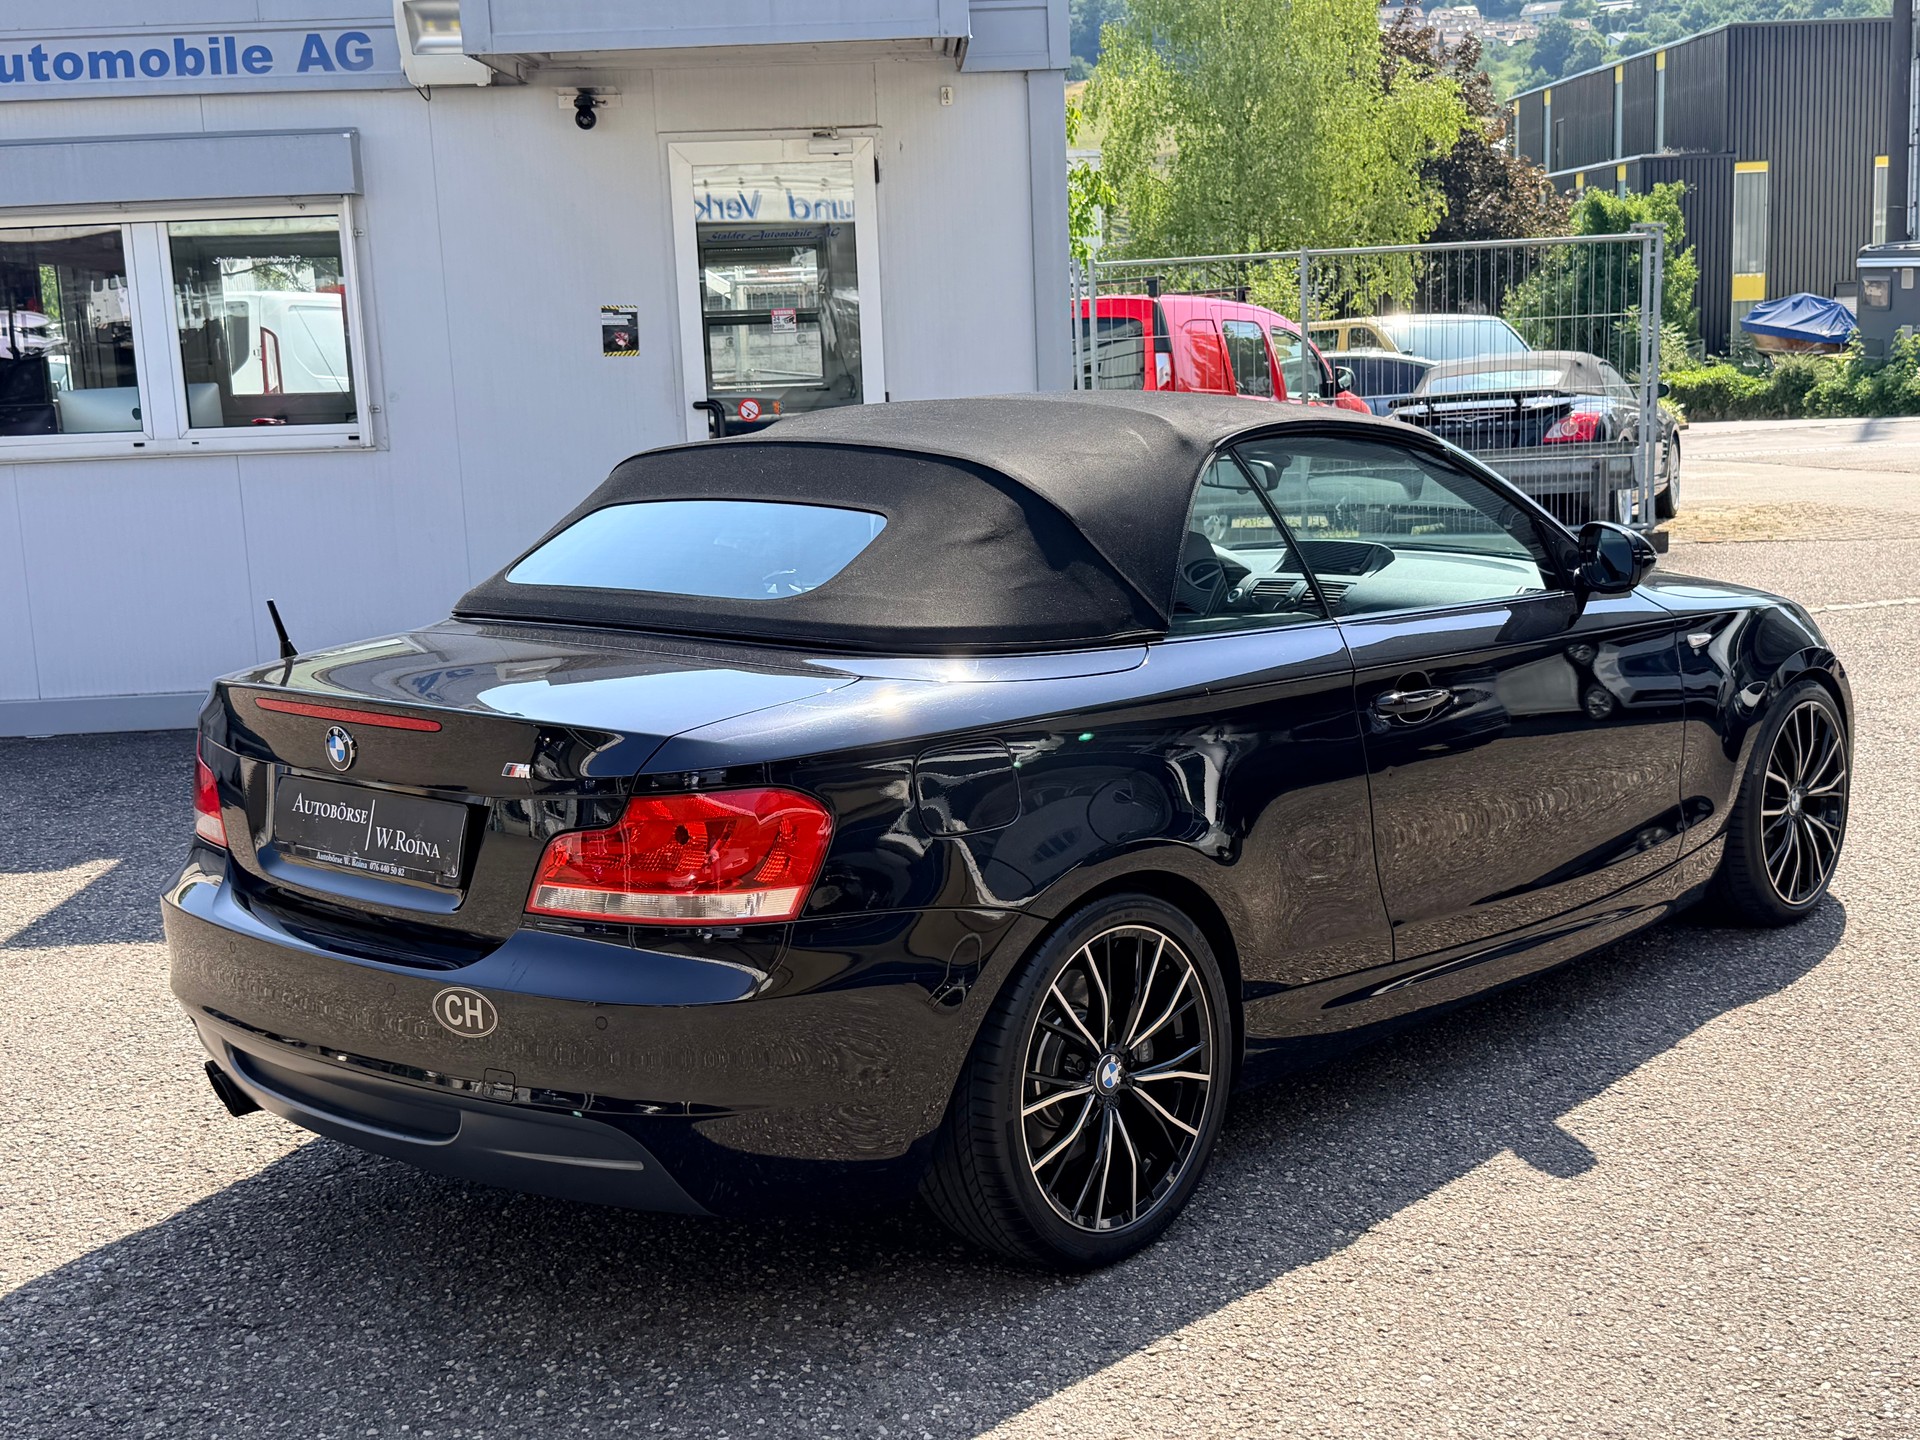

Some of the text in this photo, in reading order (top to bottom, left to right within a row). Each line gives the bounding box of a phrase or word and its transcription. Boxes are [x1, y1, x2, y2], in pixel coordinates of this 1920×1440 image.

[0, 31, 374, 83] utomobile AG
[707, 231, 746, 242] Stalder
[749, 229, 812, 240] Automobile
[316, 851, 343, 864] Autobörse
[351, 858, 367, 869] Roina
[444, 994, 484, 1030] CH
